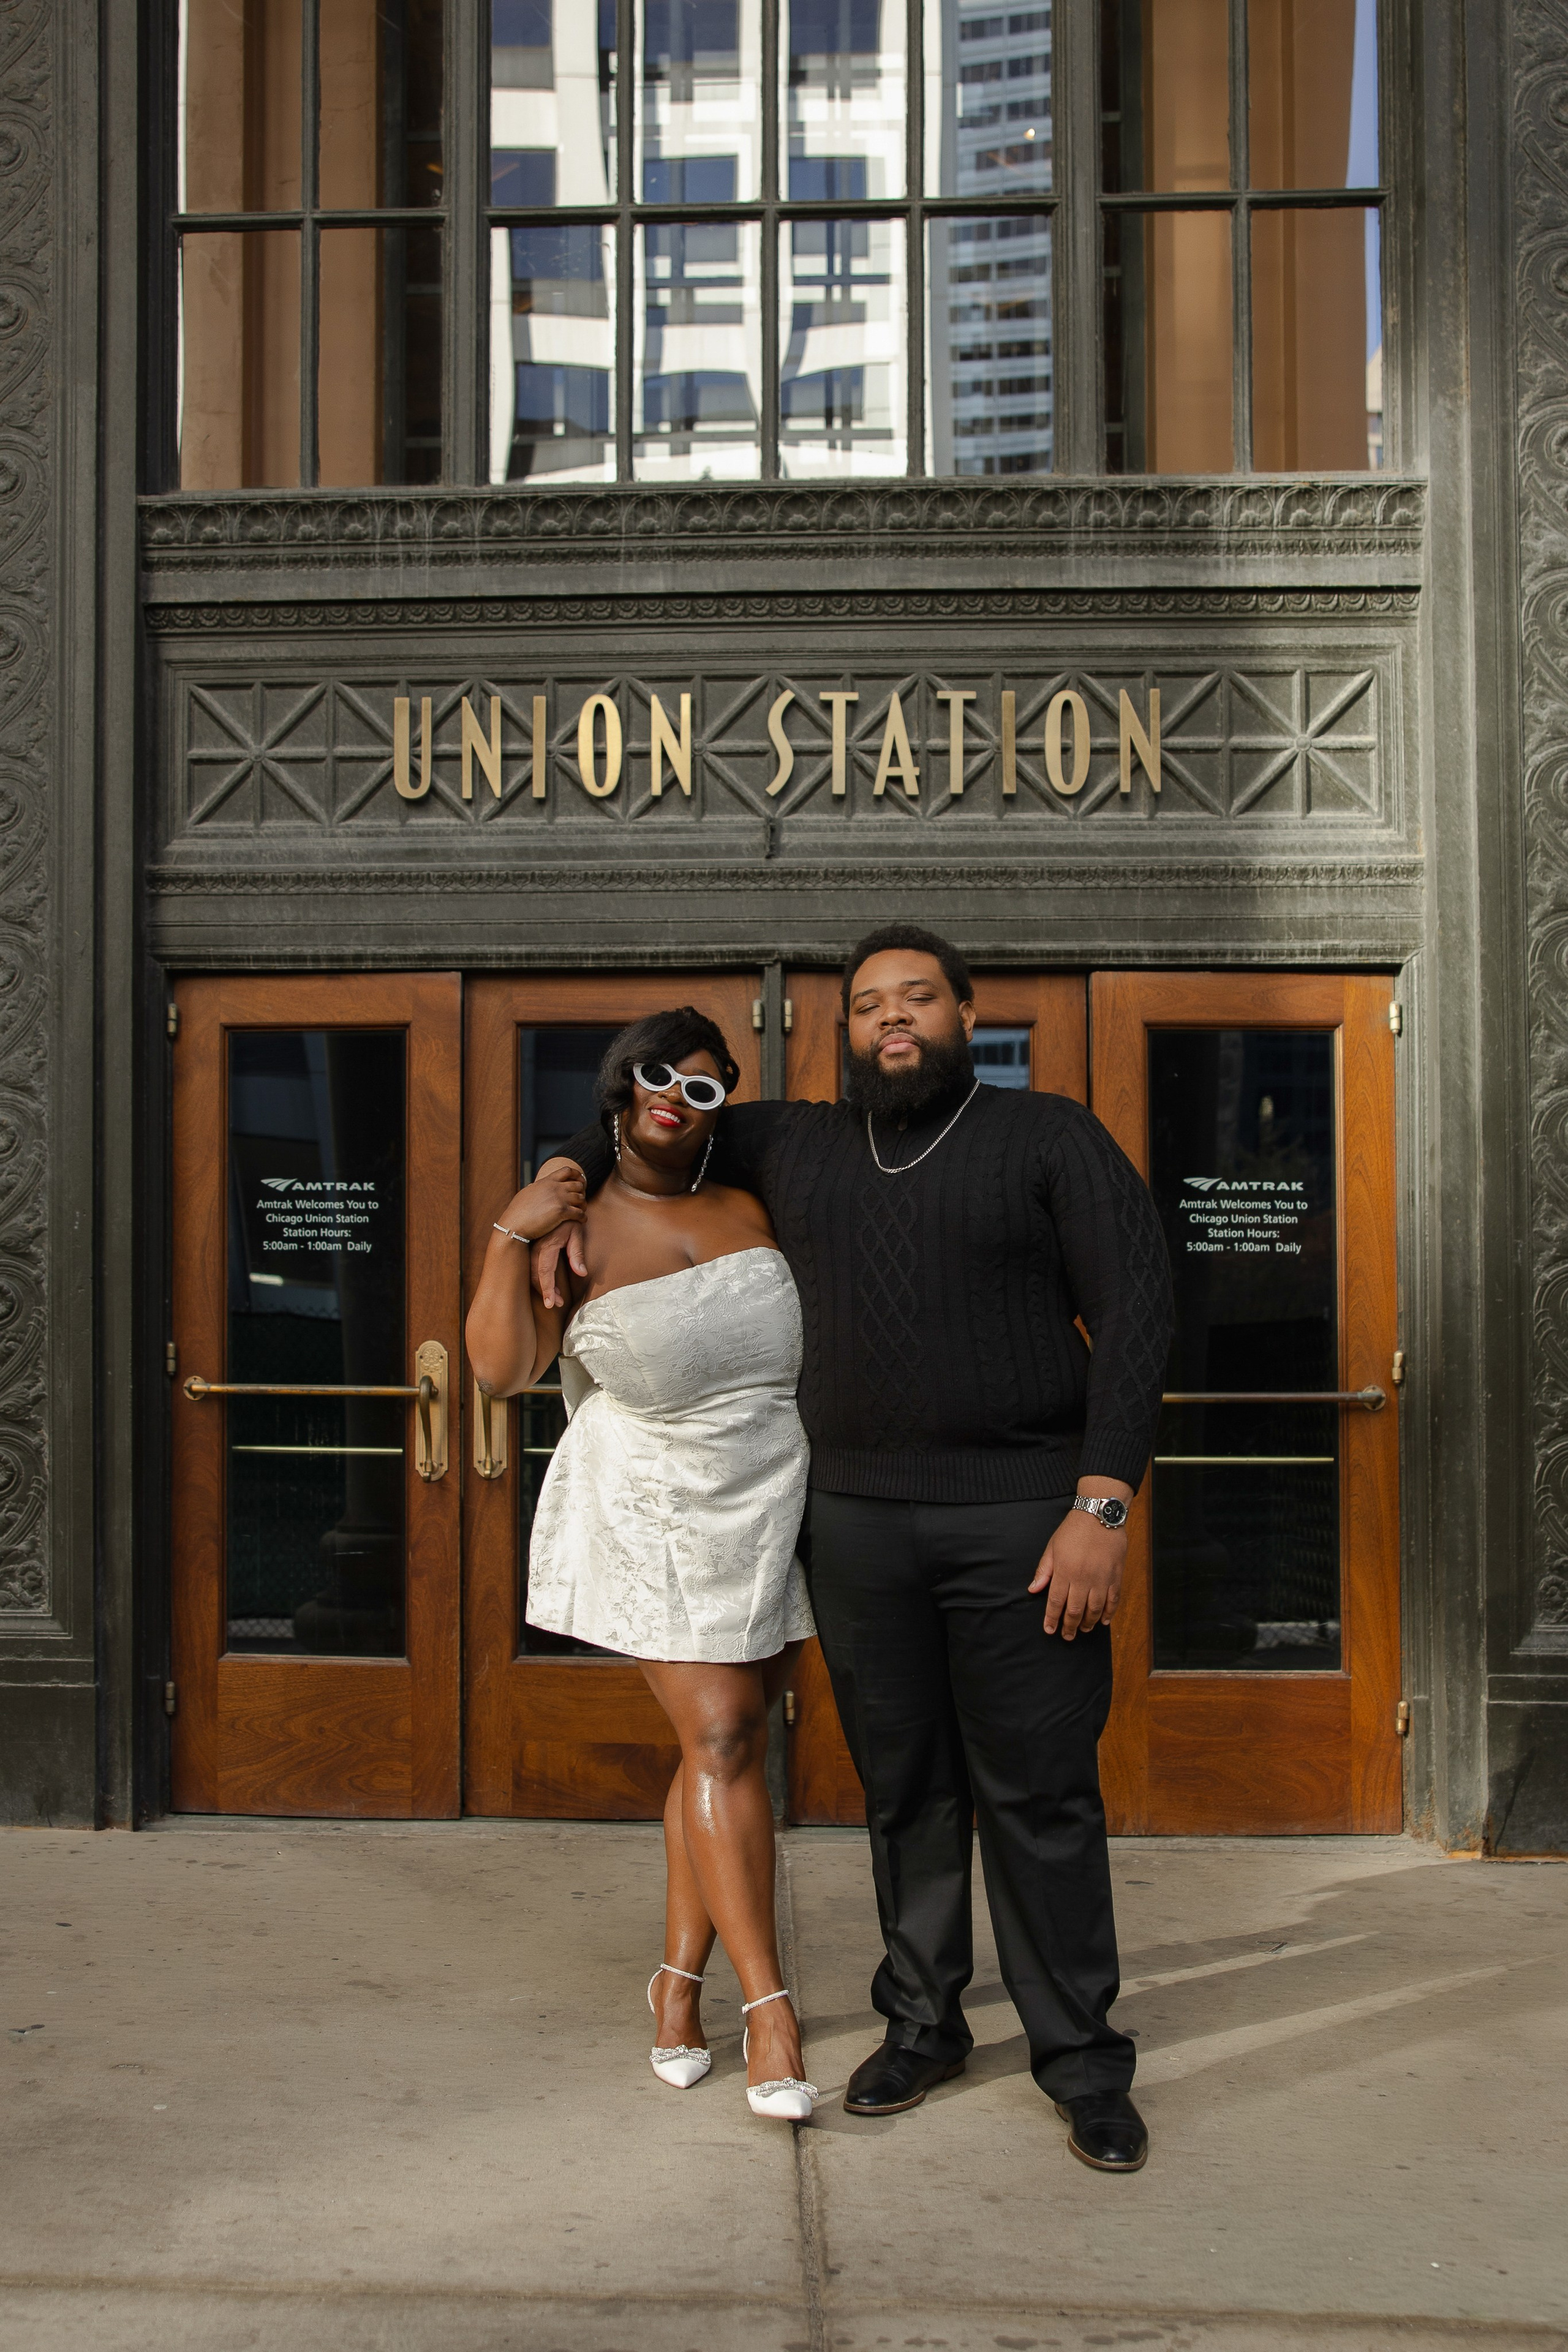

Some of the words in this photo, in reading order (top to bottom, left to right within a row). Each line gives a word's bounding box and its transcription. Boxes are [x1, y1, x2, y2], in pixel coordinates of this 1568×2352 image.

[393, 693, 692, 800] UNION
[764, 687, 1161, 797] STATION
[1216, 1182, 1303, 1191] AMTRAK
[257, 1200, 292, 1208] Amtrak
[295, 1200, 344, 1209] Welcomes
[347, 1200, 365, 1209] You
[1180, 1199, 1217, 1209] Amtrak
[1220, 1200, 1271, 1209] Welcomes
[1275, 1200, 1294, 1209] You
[266, 1213, 303, 1224] Chicago
[306, 1214, 333, 1223] Union
[336, 1214, 369, 1223] Station
[1189, 1214, 1228, 1225] Chicago
[1231, 1215, 1260, 1223] Union
[1263, 1215, 1298, 1224] Station
[283, 1228, 317, 1237] Station
[320, 1228, 351, 1237] Hours:
[1208, 1228, 1244, 1237] Station
[1247, 1229, 1280, 1238] Hours:
[263, 1241, 297, 1250] 5:00am
[307, 1242, 341, 1250] 1:00am
[347, 1242, 372, 1253] Daily
[1187, 1242, 1223, 1251] 5:00am
[1234, 1243, 1270, 1251] 1:00am
[1276, 1243, 1301, 1254] Daily
